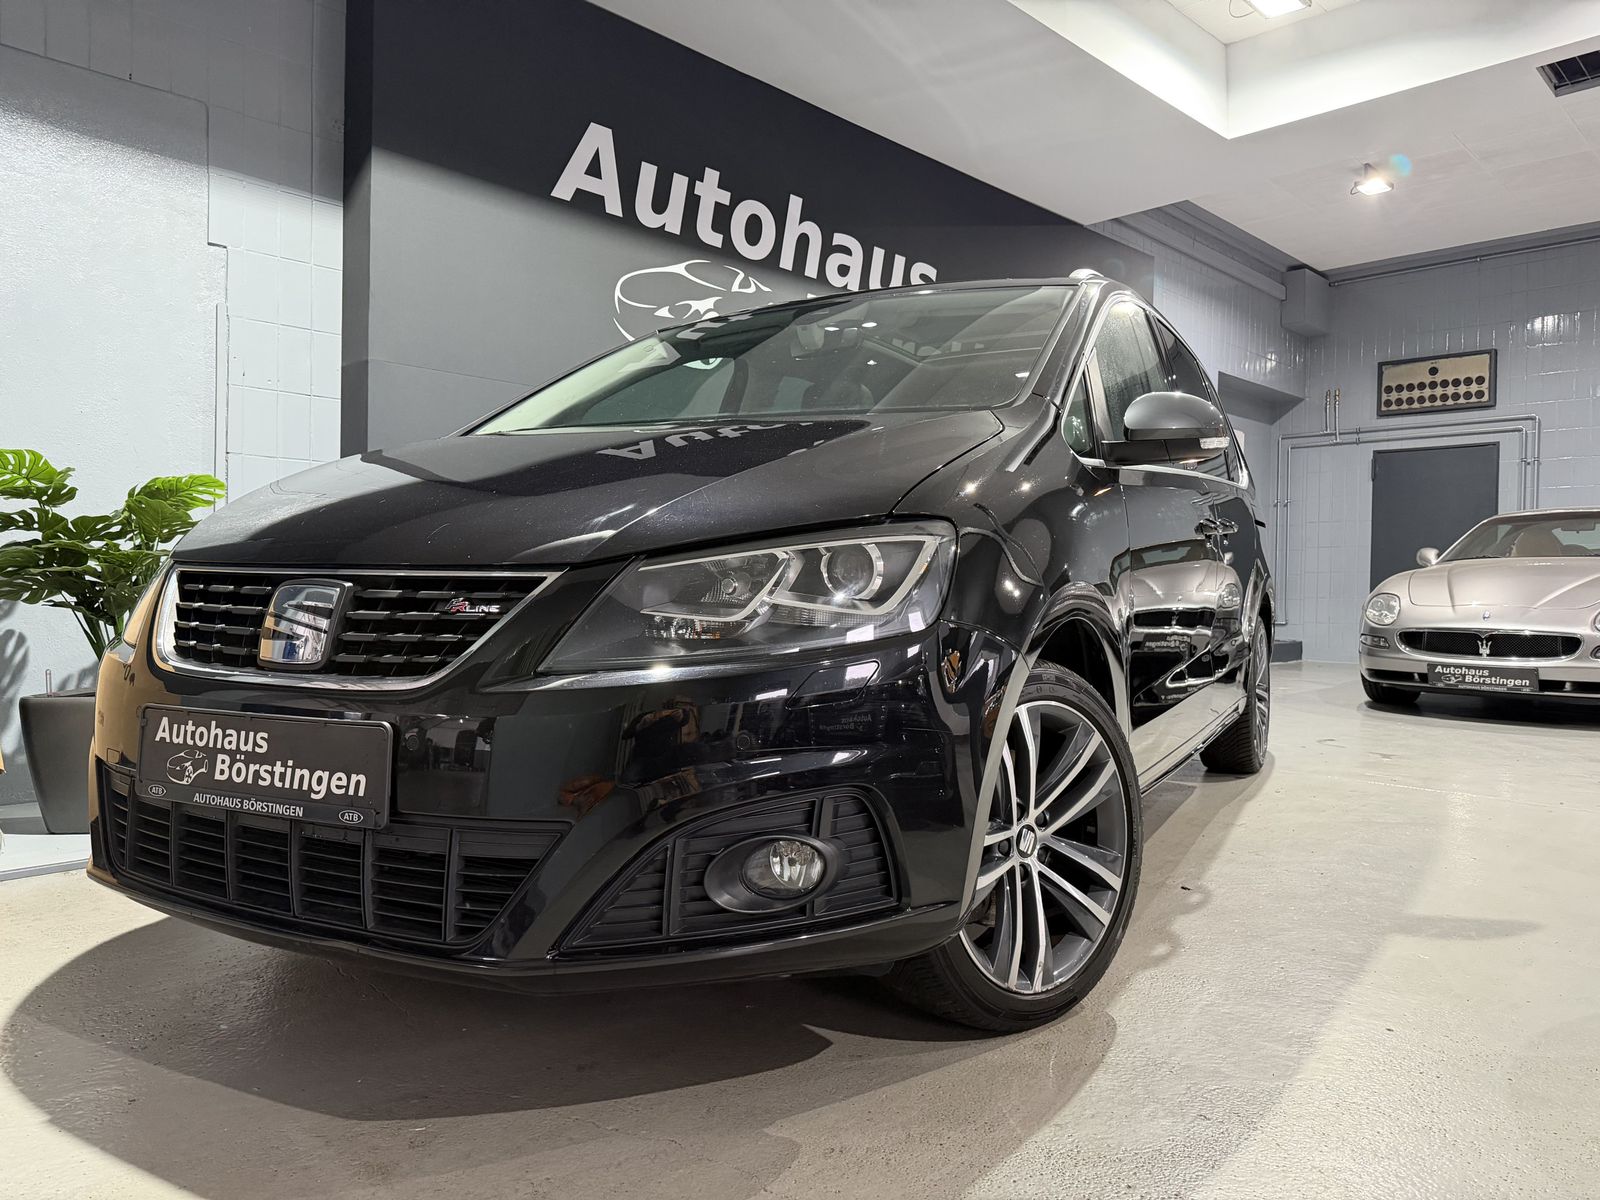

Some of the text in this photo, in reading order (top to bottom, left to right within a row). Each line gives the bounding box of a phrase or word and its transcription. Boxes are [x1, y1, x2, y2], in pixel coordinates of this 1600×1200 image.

[1435, 665, 1489, 676] Autohaus
[1465, 675, 1530, 687] Börstingen
[155, 716, 269, 753] Autohaus
[214, 753, 367, 800] Börstingen
[151, 786, 163, 795] ATB
[193, 792, 304, 817] AUTOHAUS BÖRSTINGEN
[343, 812, 359, 822] ATB
